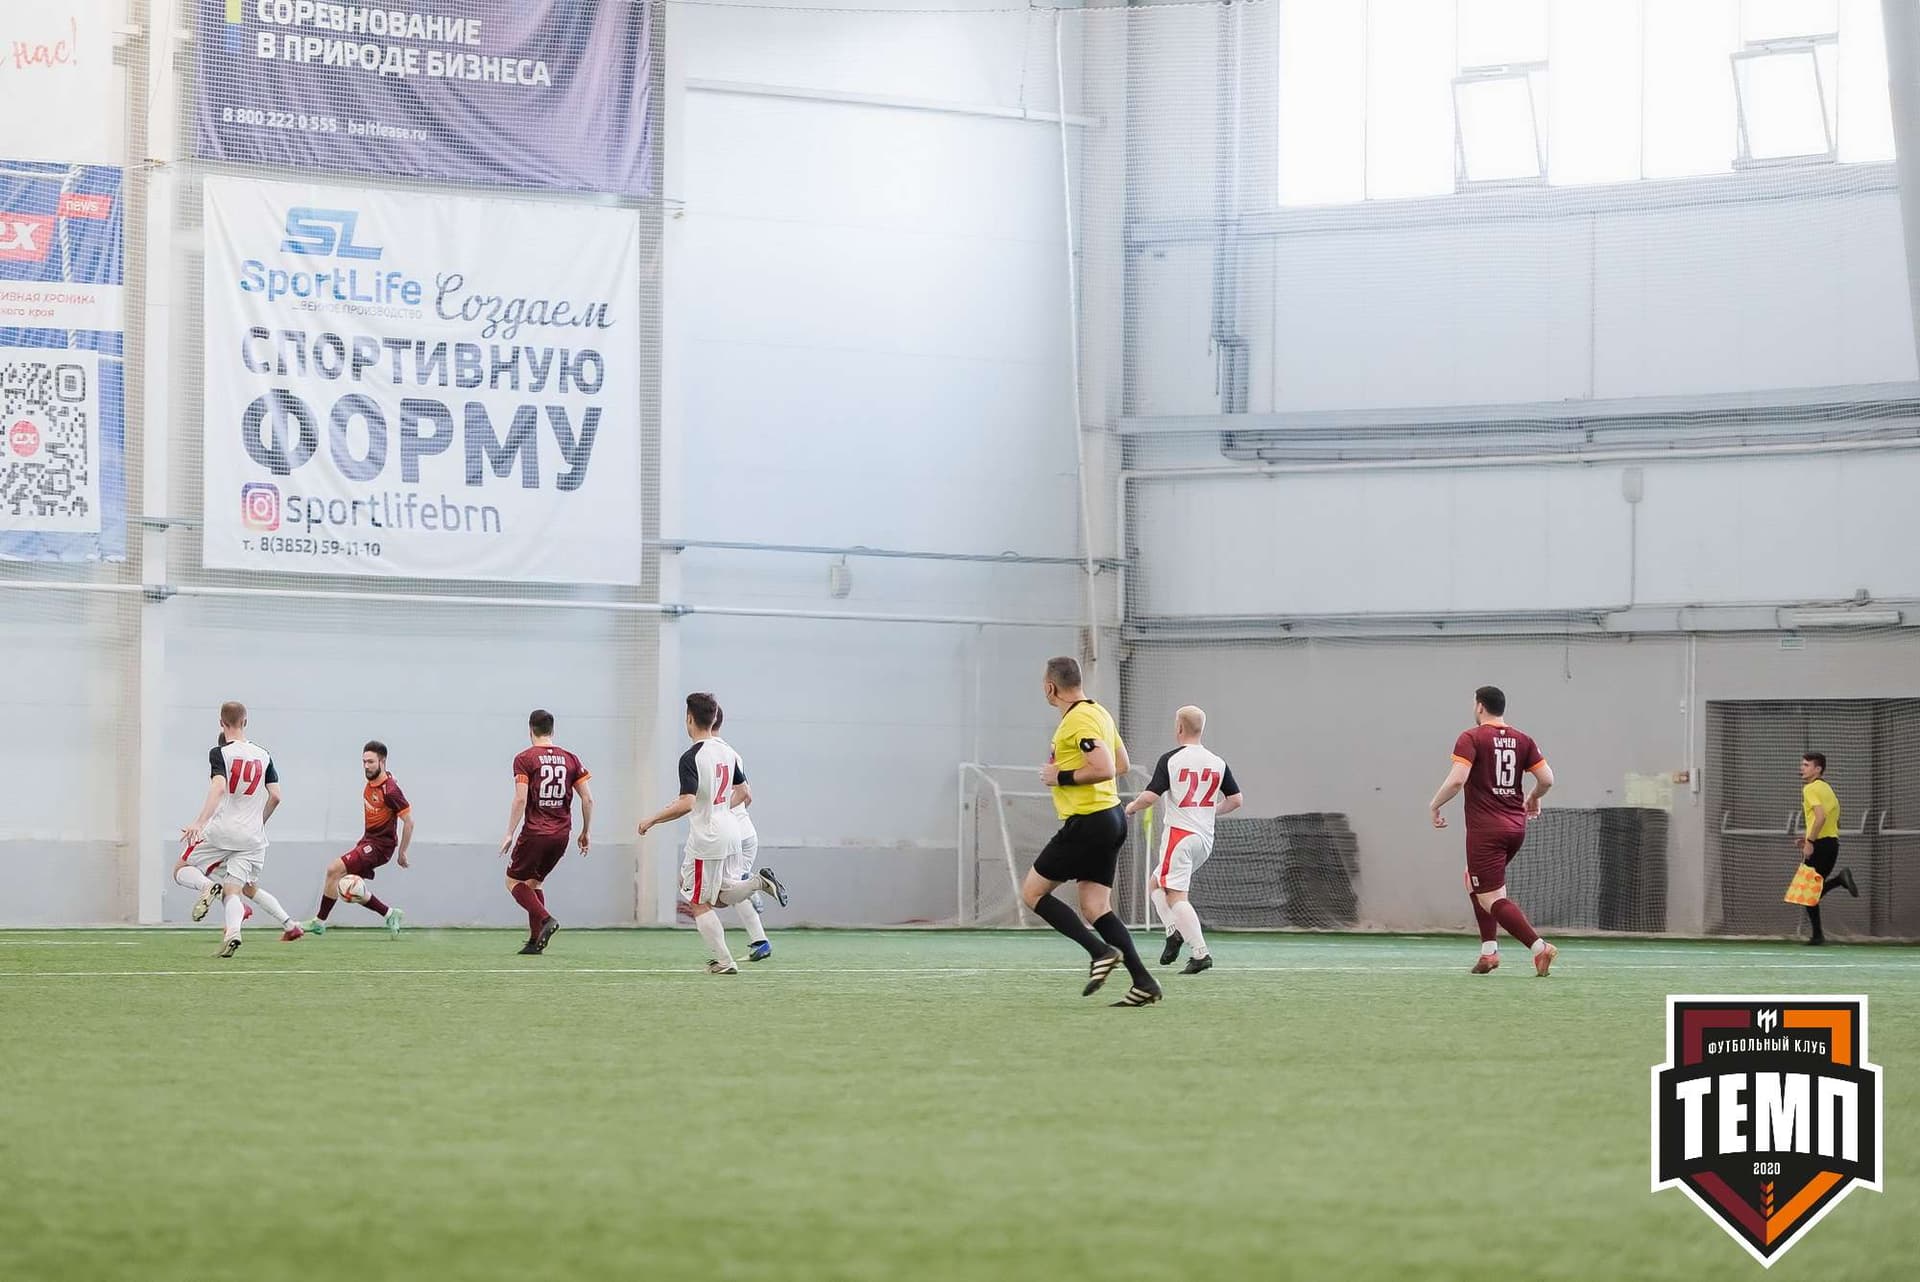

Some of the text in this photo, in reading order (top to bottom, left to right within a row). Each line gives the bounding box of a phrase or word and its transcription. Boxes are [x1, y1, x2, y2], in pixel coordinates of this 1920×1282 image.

[258, 0, 482, 45] СОРЕВНОВАНИЕ
[258, 31, 551, 87] В ПРИРОДЕ БИЗНЕСА
[223, 107, 233, 122] 8
[236, 109, 264, 125] 800
[266, 112, 295, 129] 222
[298, 115, 307, 130] 0
[310, 117, 337, 132] 555
[65, 200, 98, 212] news
[240, 260, 422, 306] SportLife
[436, 271, 616, 340] Создаем
[242, 326, 605, 394] СПОРТИВНУЮ
[241, 388, 603, 491] ФОРМУ
[286, 492, 501, 533] sportlifebrn
[260, 536, 318, 555] 8(3852)
[229, 759, 263, 796] 19
[539, 765, 567, 799] 23
[713, 762, 729, 806] 2
[1178, 768, 1220, 808] 22
[1495, 749, 1516, 787] 13
